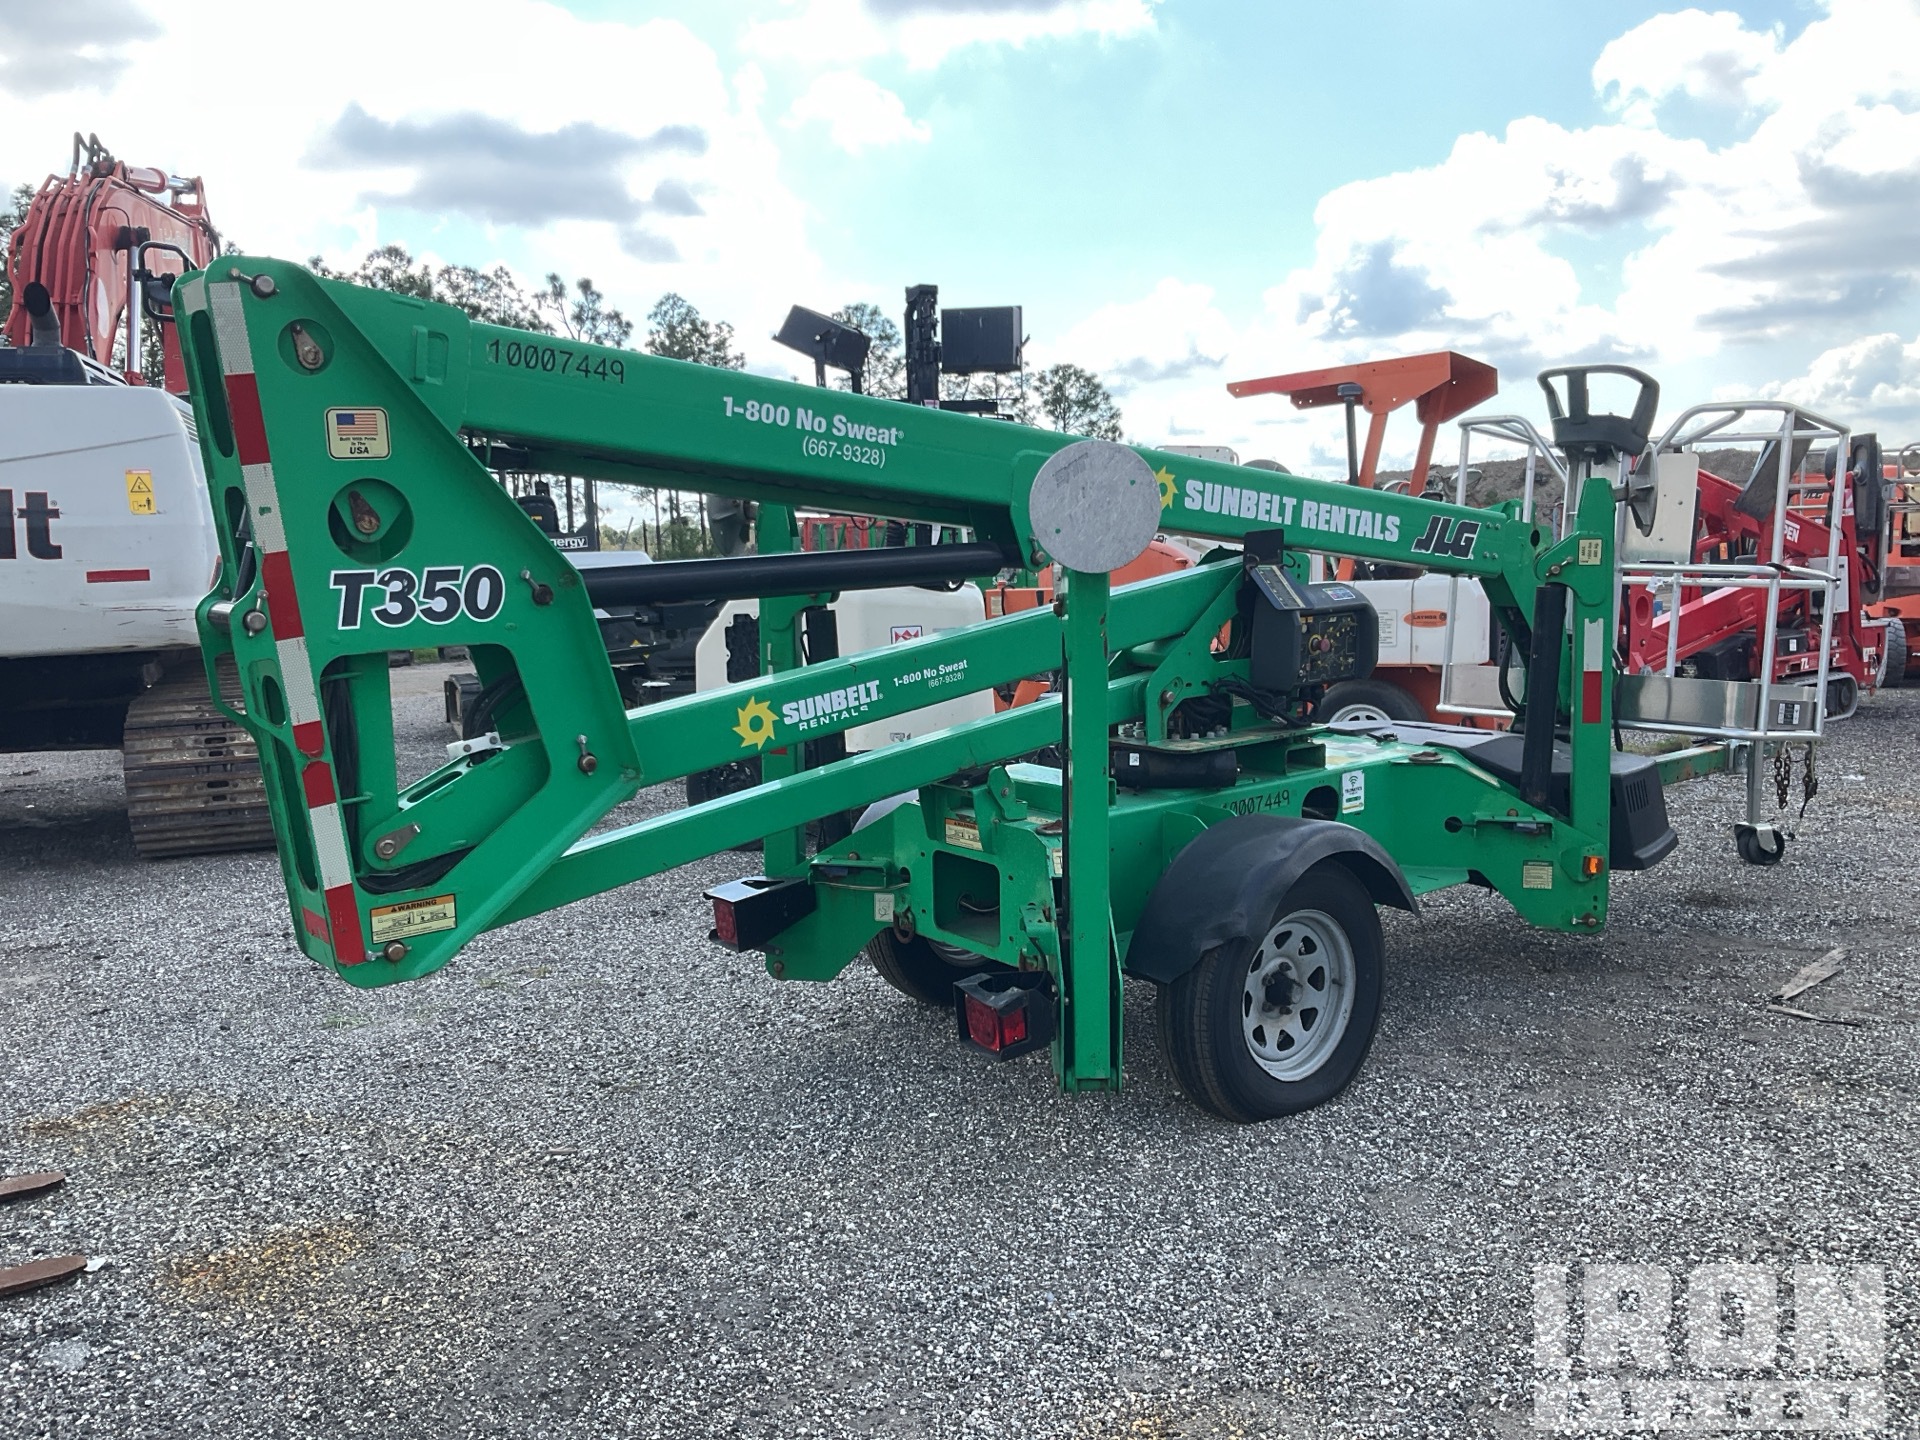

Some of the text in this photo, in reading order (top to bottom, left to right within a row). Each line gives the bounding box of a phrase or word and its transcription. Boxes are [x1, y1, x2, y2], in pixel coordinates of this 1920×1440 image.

[489, 339, 625, 384] 10007449
[723, 396, 897, 446] 1-800 No Sweat
[349, 446, 370, 455] USA
[802, 435, 886, 469] (667-9328)
[1184, 479, 1401, 542] SUNBELT RENTALS
[1411, 513, 1482, 561] JLG
[329, 563, 507, 631] T350
[893, 659, 968, 688] 1-800 No Sweat
[927, 671, 965, 689] (667-9328)
[782, 679, 881, 726] SUNBELT
[397, 899, 437, 912] WARNING
